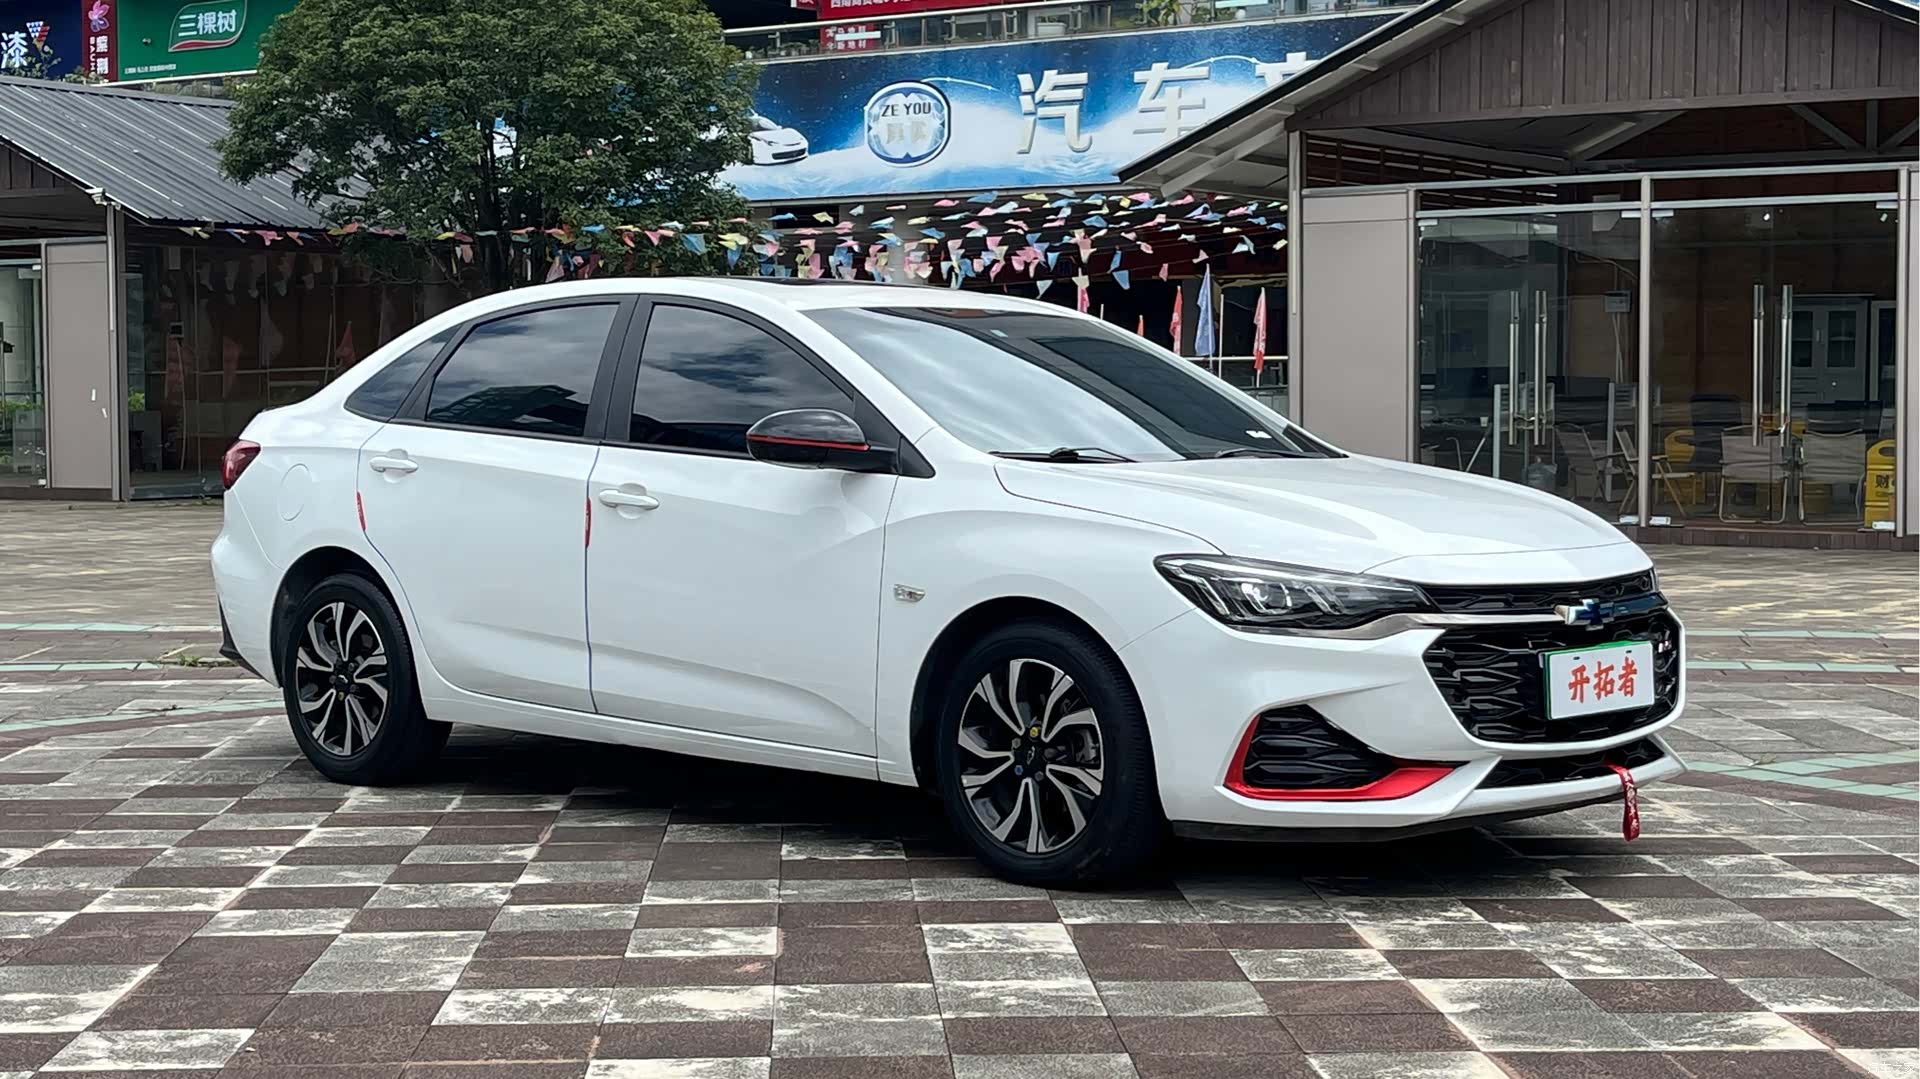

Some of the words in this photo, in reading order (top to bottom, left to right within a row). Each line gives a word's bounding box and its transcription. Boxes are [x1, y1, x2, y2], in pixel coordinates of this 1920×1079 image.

[178, 9, 237, 37] 三棵树
[0, 31, 28, 69] 漆
[881, 104, 899, 117] ZE
[903, 102, 932, 115] YOU
[1568, 656, 1638, 703] 开拓者
